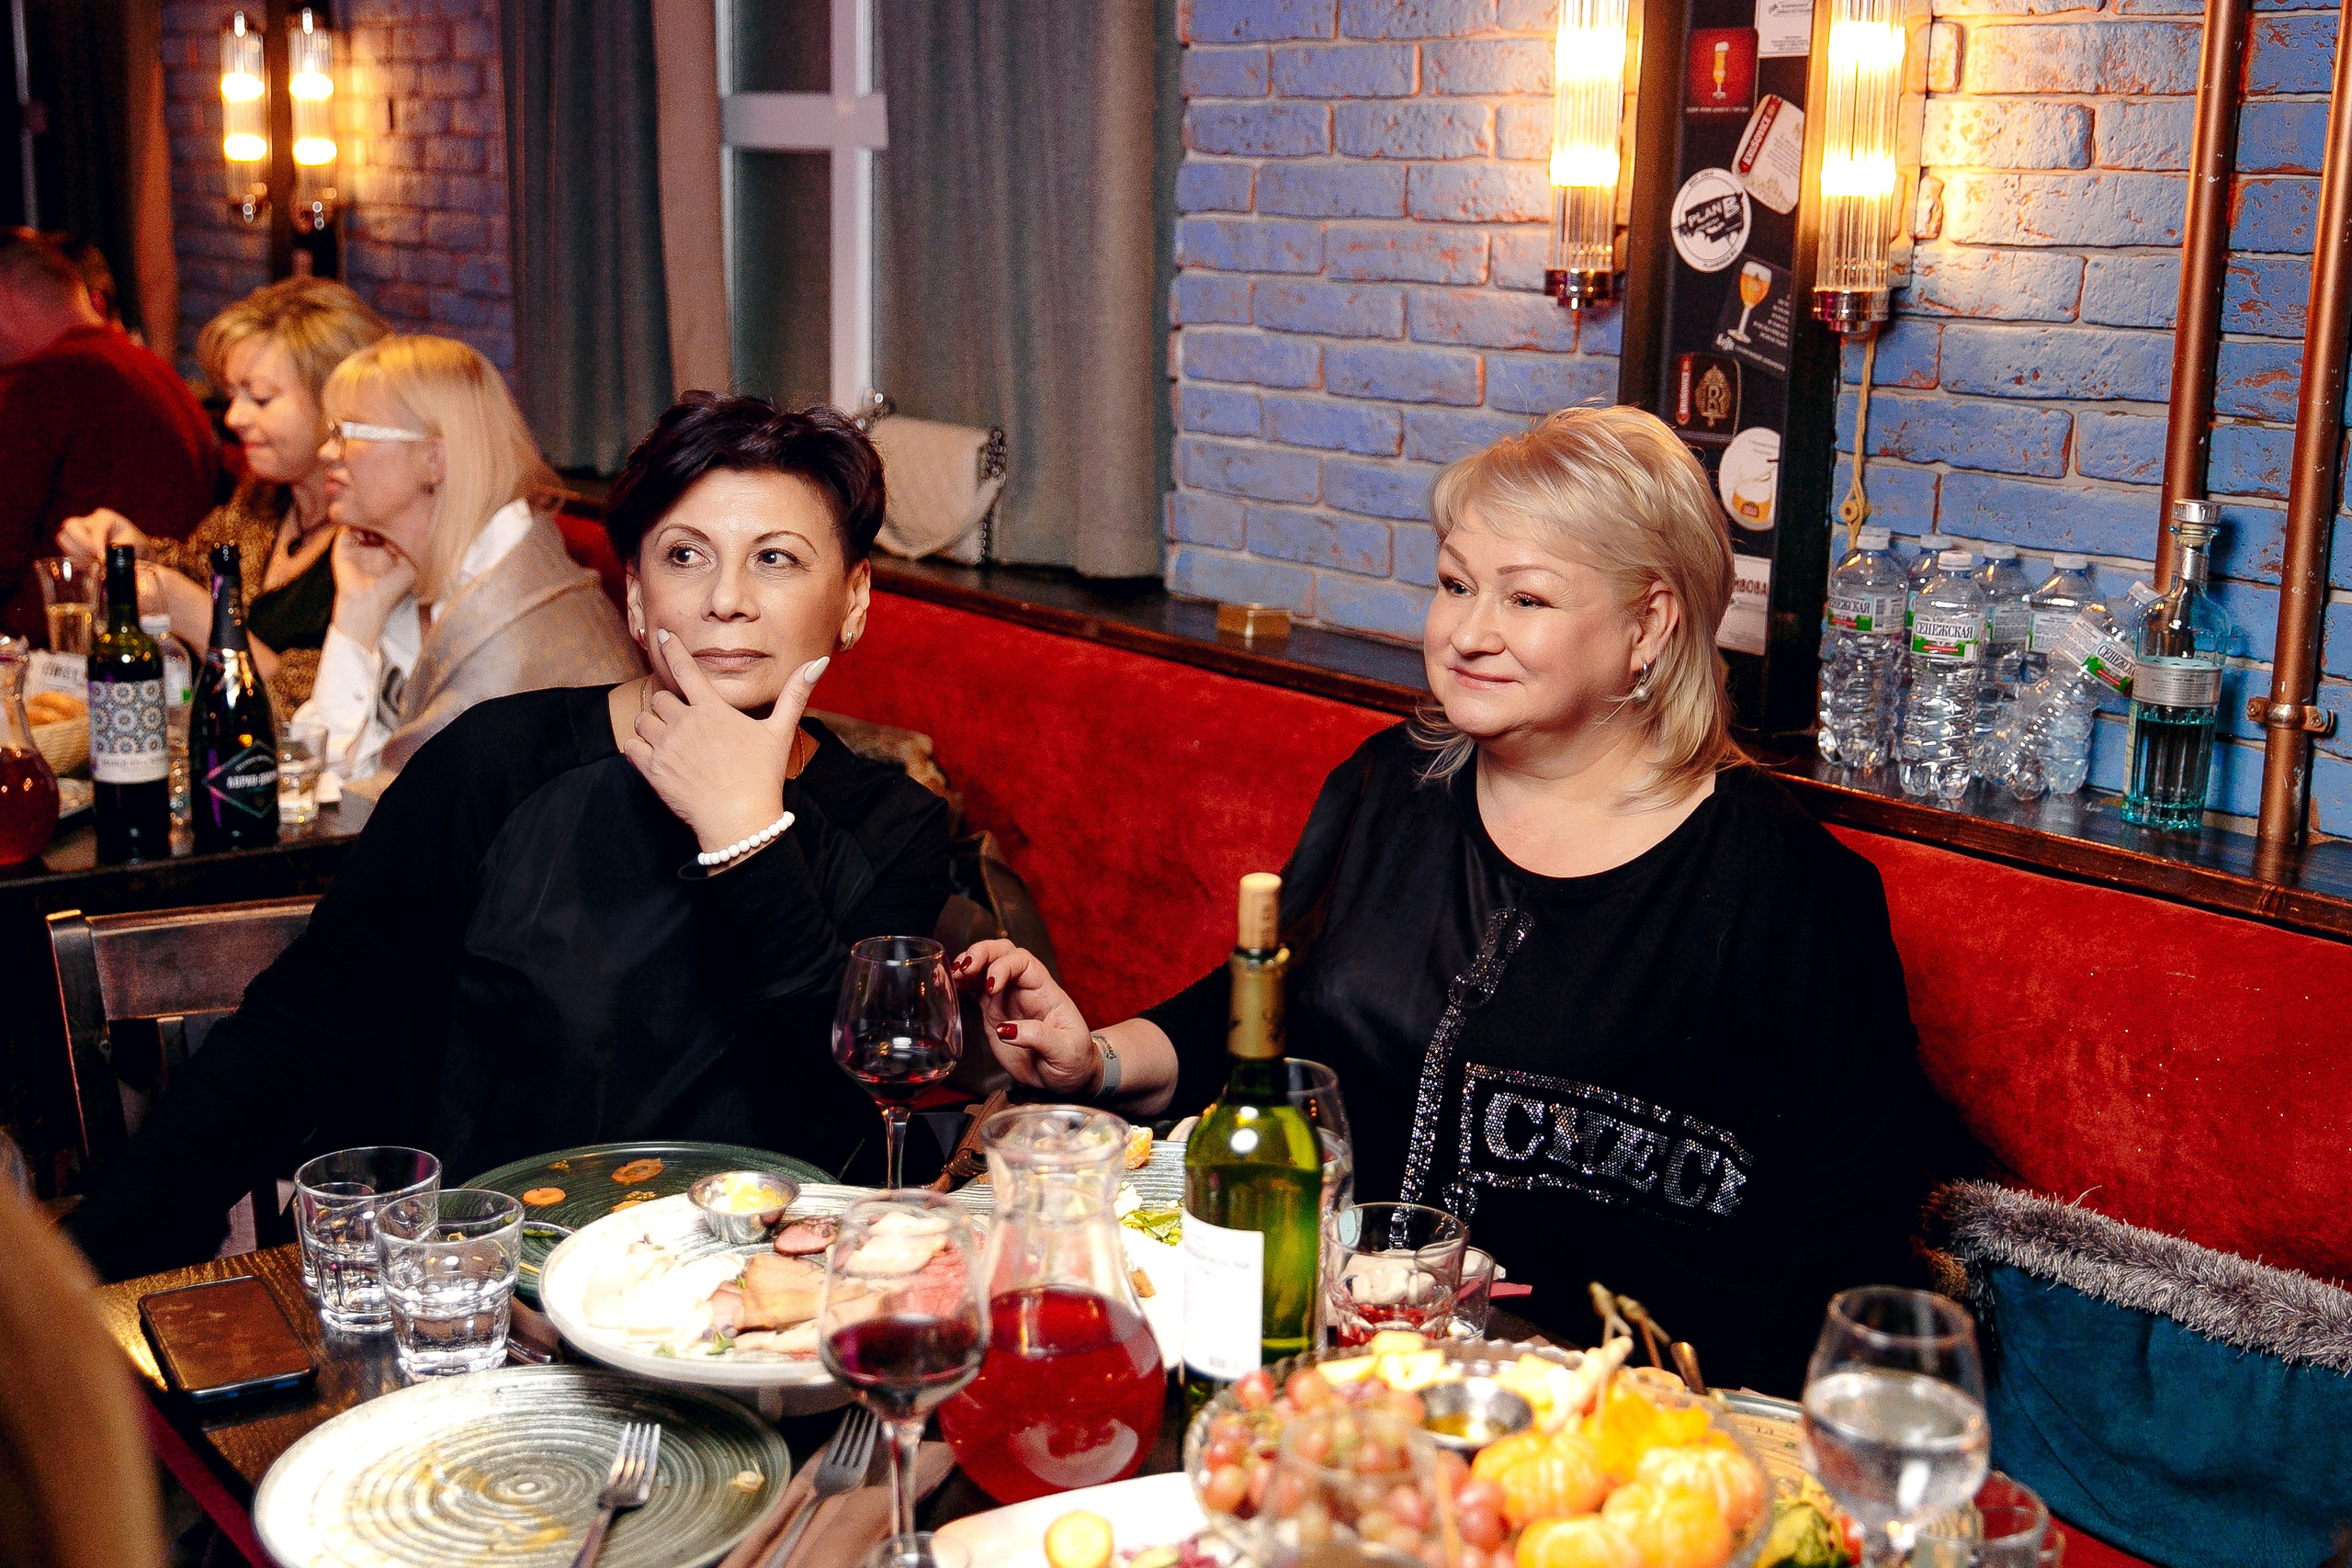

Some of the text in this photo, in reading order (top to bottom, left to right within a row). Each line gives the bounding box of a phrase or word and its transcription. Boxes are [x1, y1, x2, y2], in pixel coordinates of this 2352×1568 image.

[1687, 201, 1723, 228] PLAN
[1722, 195, 1741, 220] B
[1915, 622, 1974, 638] СЕНЕЖСКАЯ
